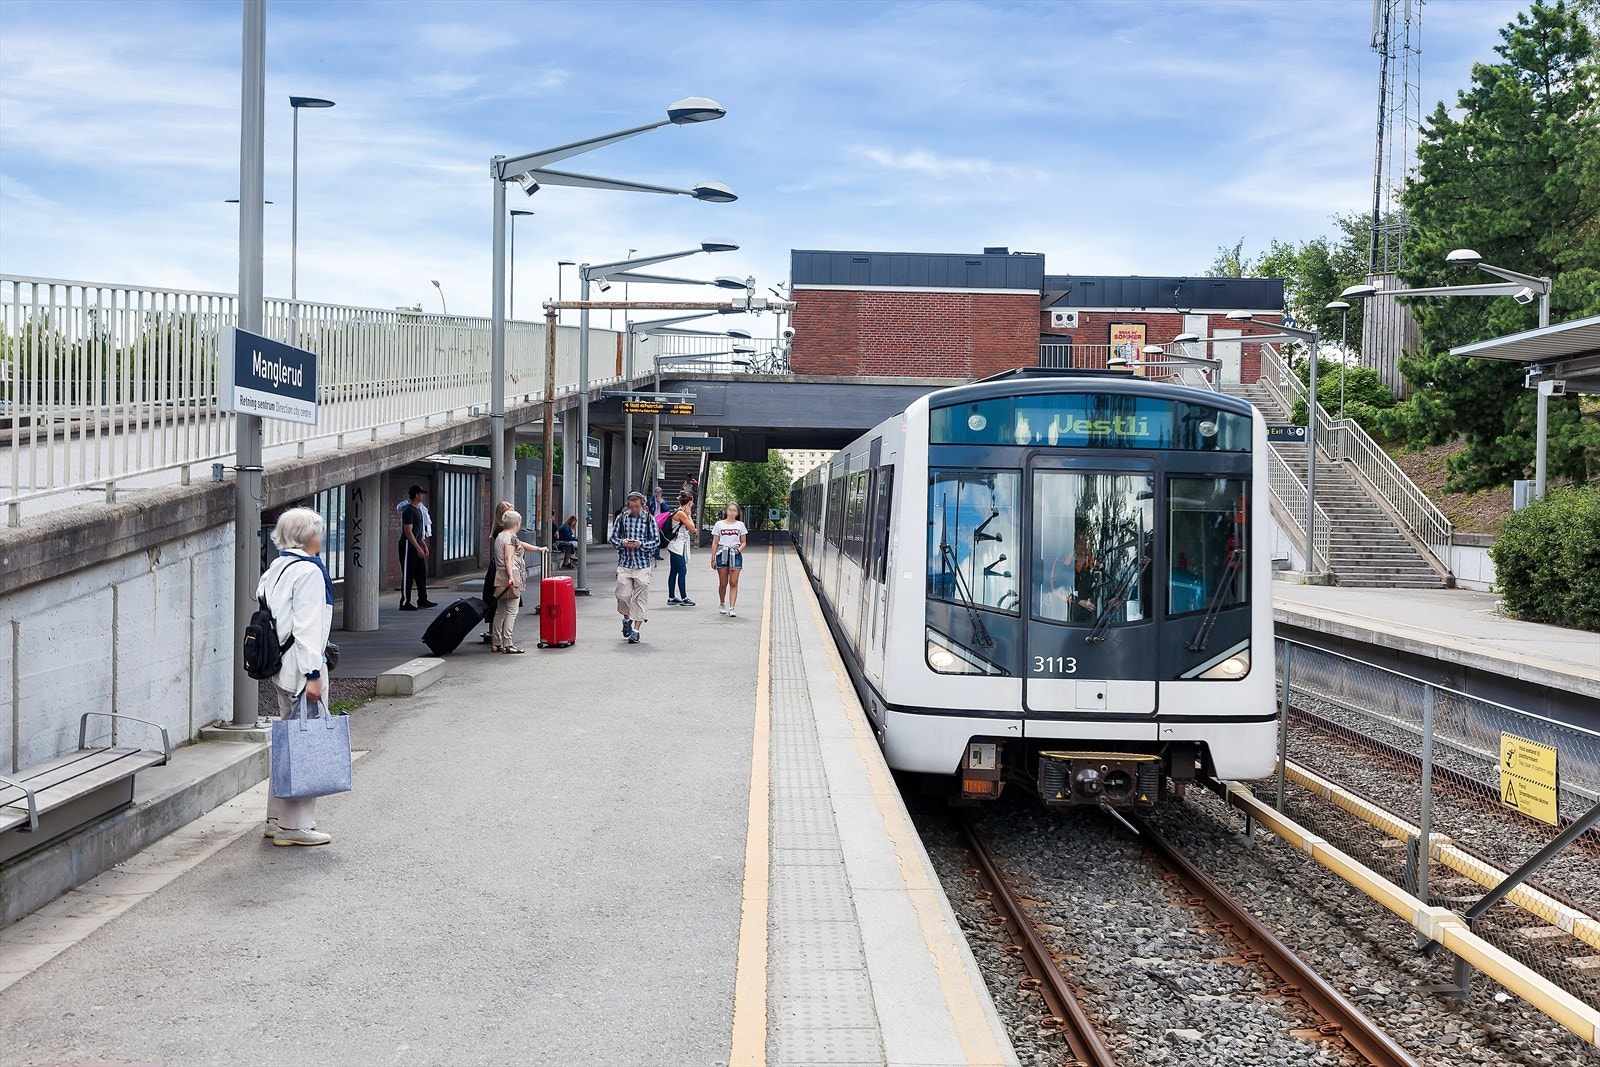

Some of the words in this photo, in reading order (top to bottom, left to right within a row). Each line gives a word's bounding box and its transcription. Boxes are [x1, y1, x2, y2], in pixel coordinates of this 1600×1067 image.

[252, 350, 303, 388] Manglerud
[239, 395, 257, 410] Retning
[257, 400, 276, 412] sentrum
[275, 401, 293, 415] Direction
[300, 407, 312, 418] centre
[1053, 413, 1150, 436] Vestli
[1033, 656, 1077, 674] 3113
